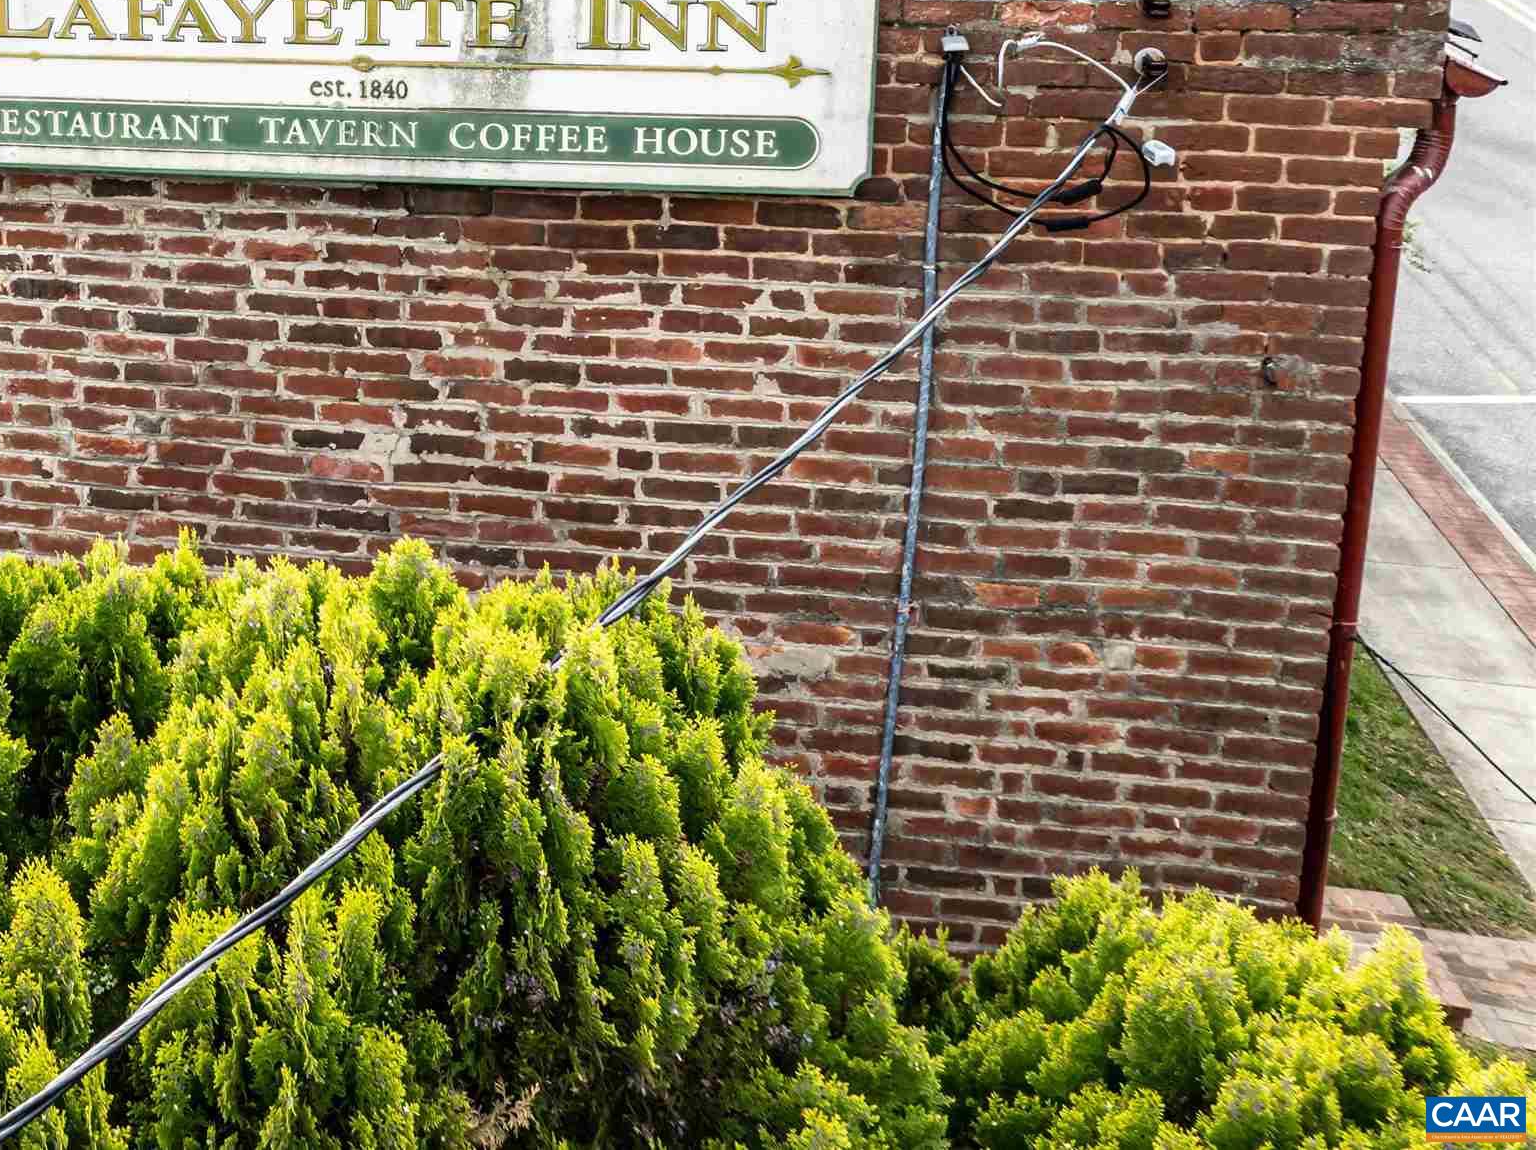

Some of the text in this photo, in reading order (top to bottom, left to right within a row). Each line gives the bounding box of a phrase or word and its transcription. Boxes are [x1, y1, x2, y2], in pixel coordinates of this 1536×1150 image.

[309, 80, 408, 100] est. 1840
[259, 116, 419, 148] TAVERN
[449, 122, 609, 154] COFFEE
[633, 126, 779, 159] HOUSE
